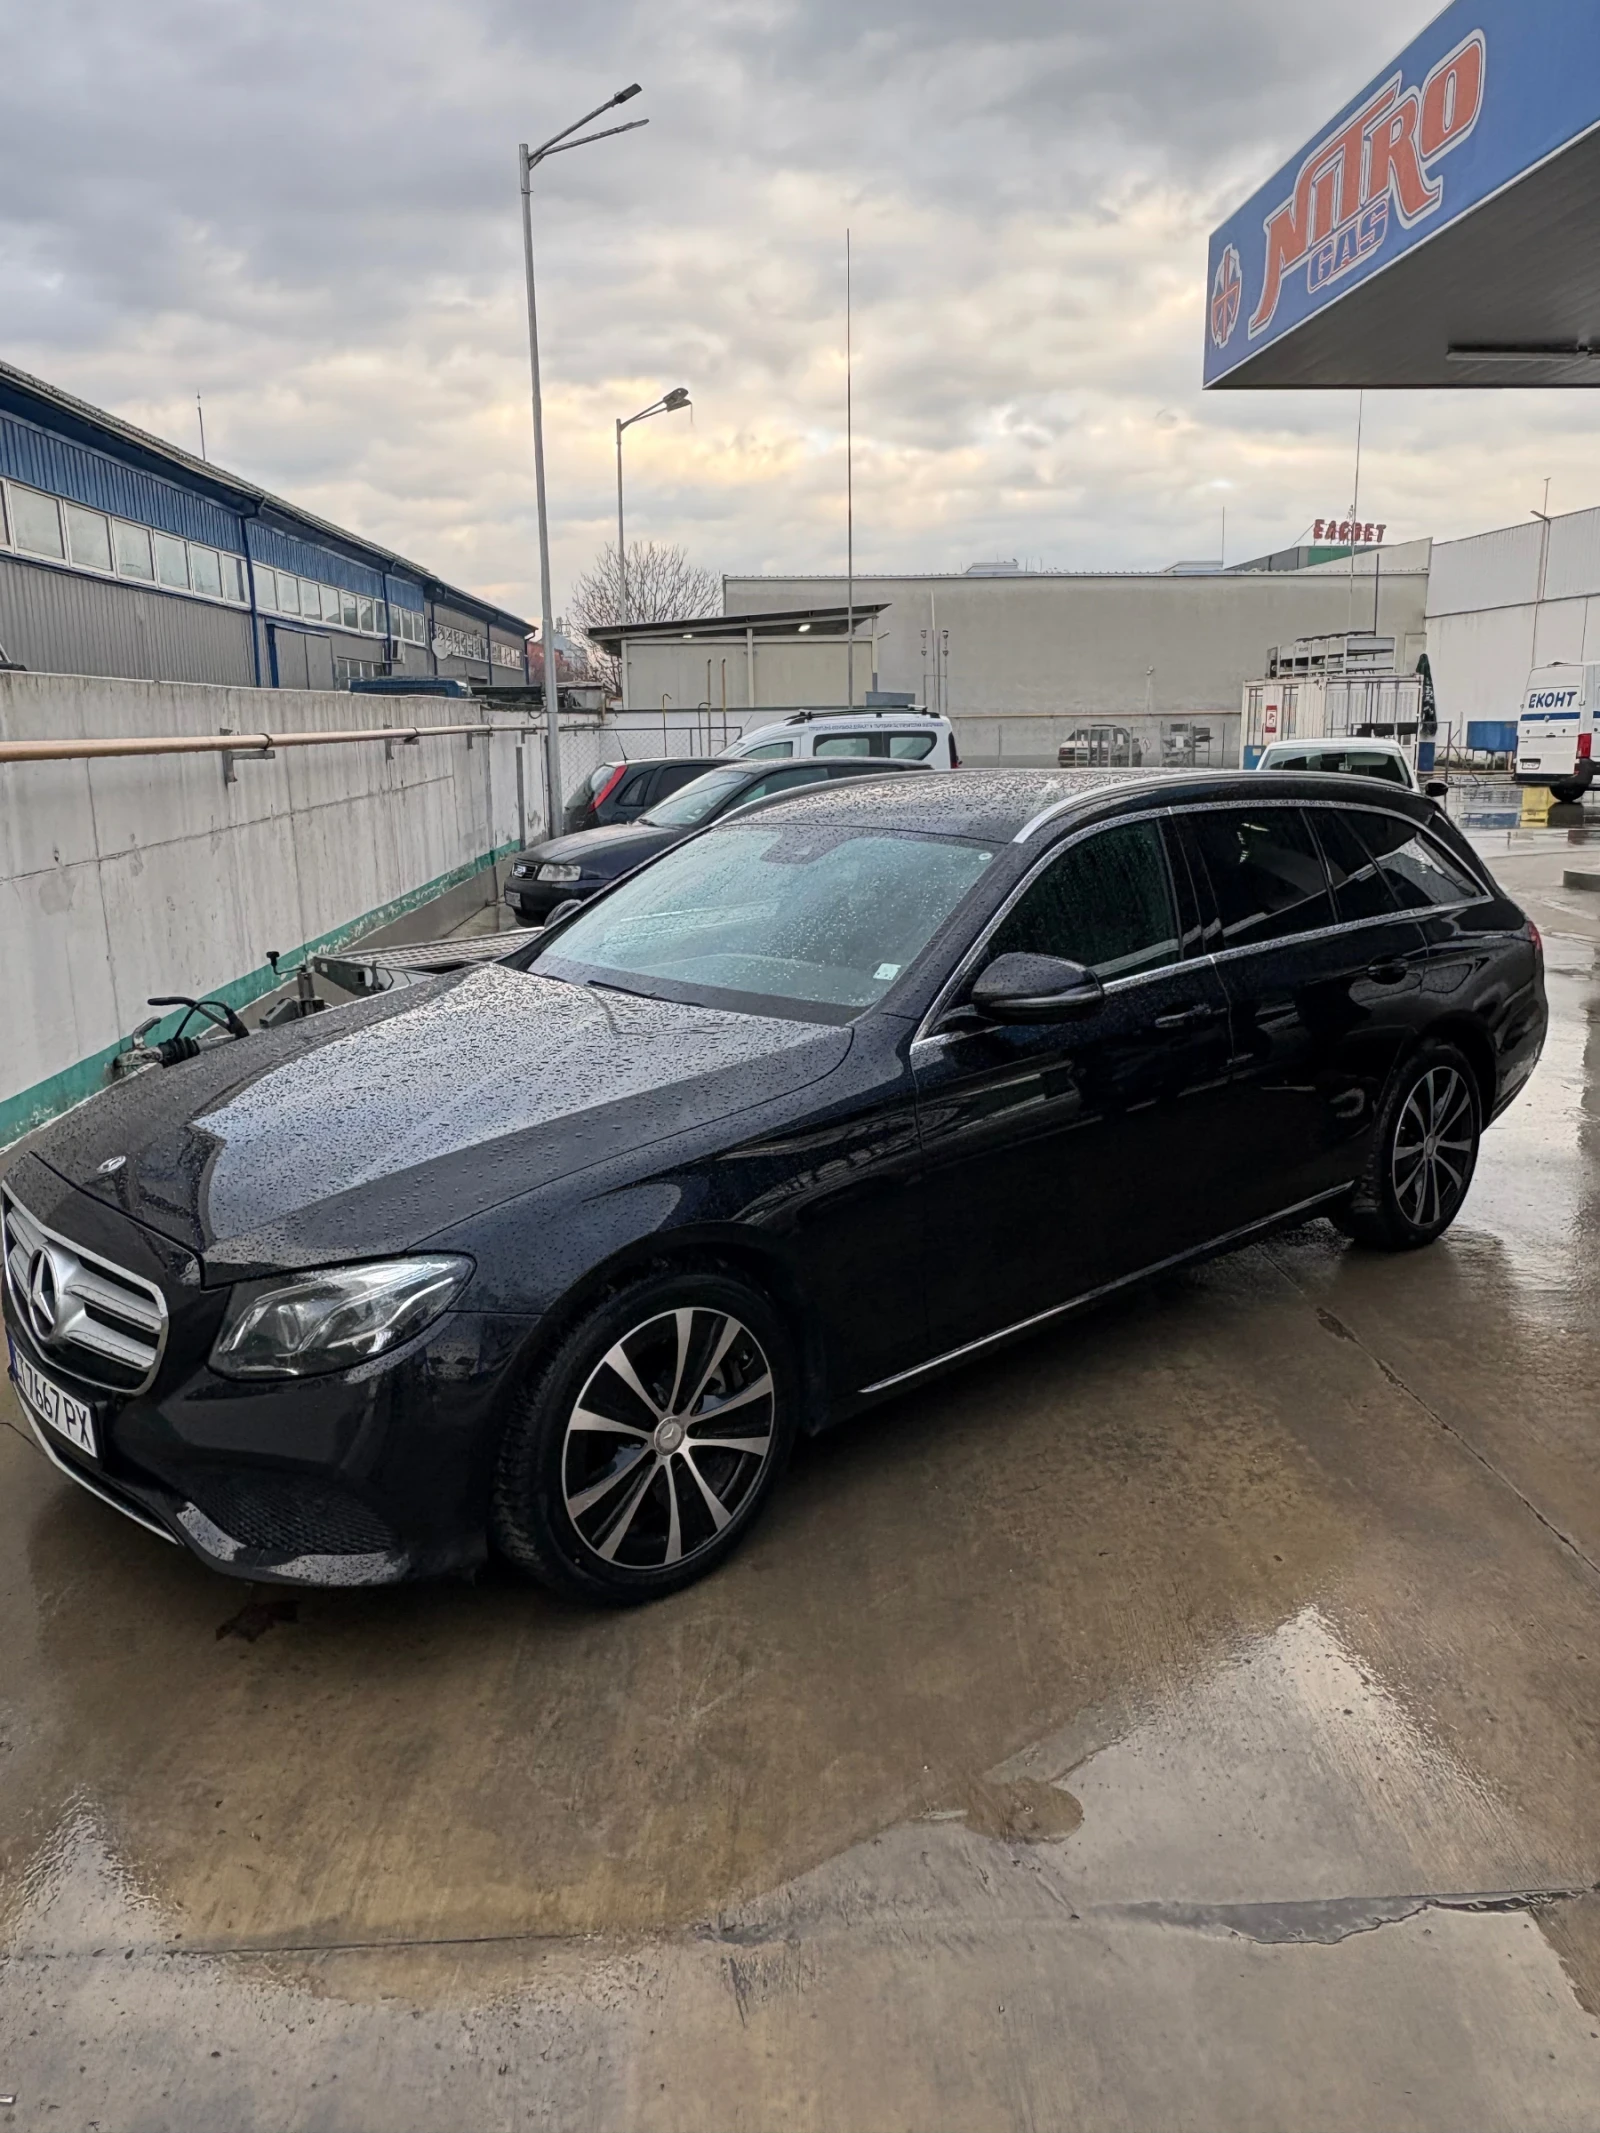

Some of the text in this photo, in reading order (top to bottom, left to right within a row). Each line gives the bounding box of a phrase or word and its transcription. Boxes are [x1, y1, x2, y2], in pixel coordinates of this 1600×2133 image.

[1249, 29, 1486, 339] NITRO
[1307, 198, 1389, 294] GAS
[1528, 691, 1577, 709] ЕКОНТ
[62, 1395, 93, 1451] PX
